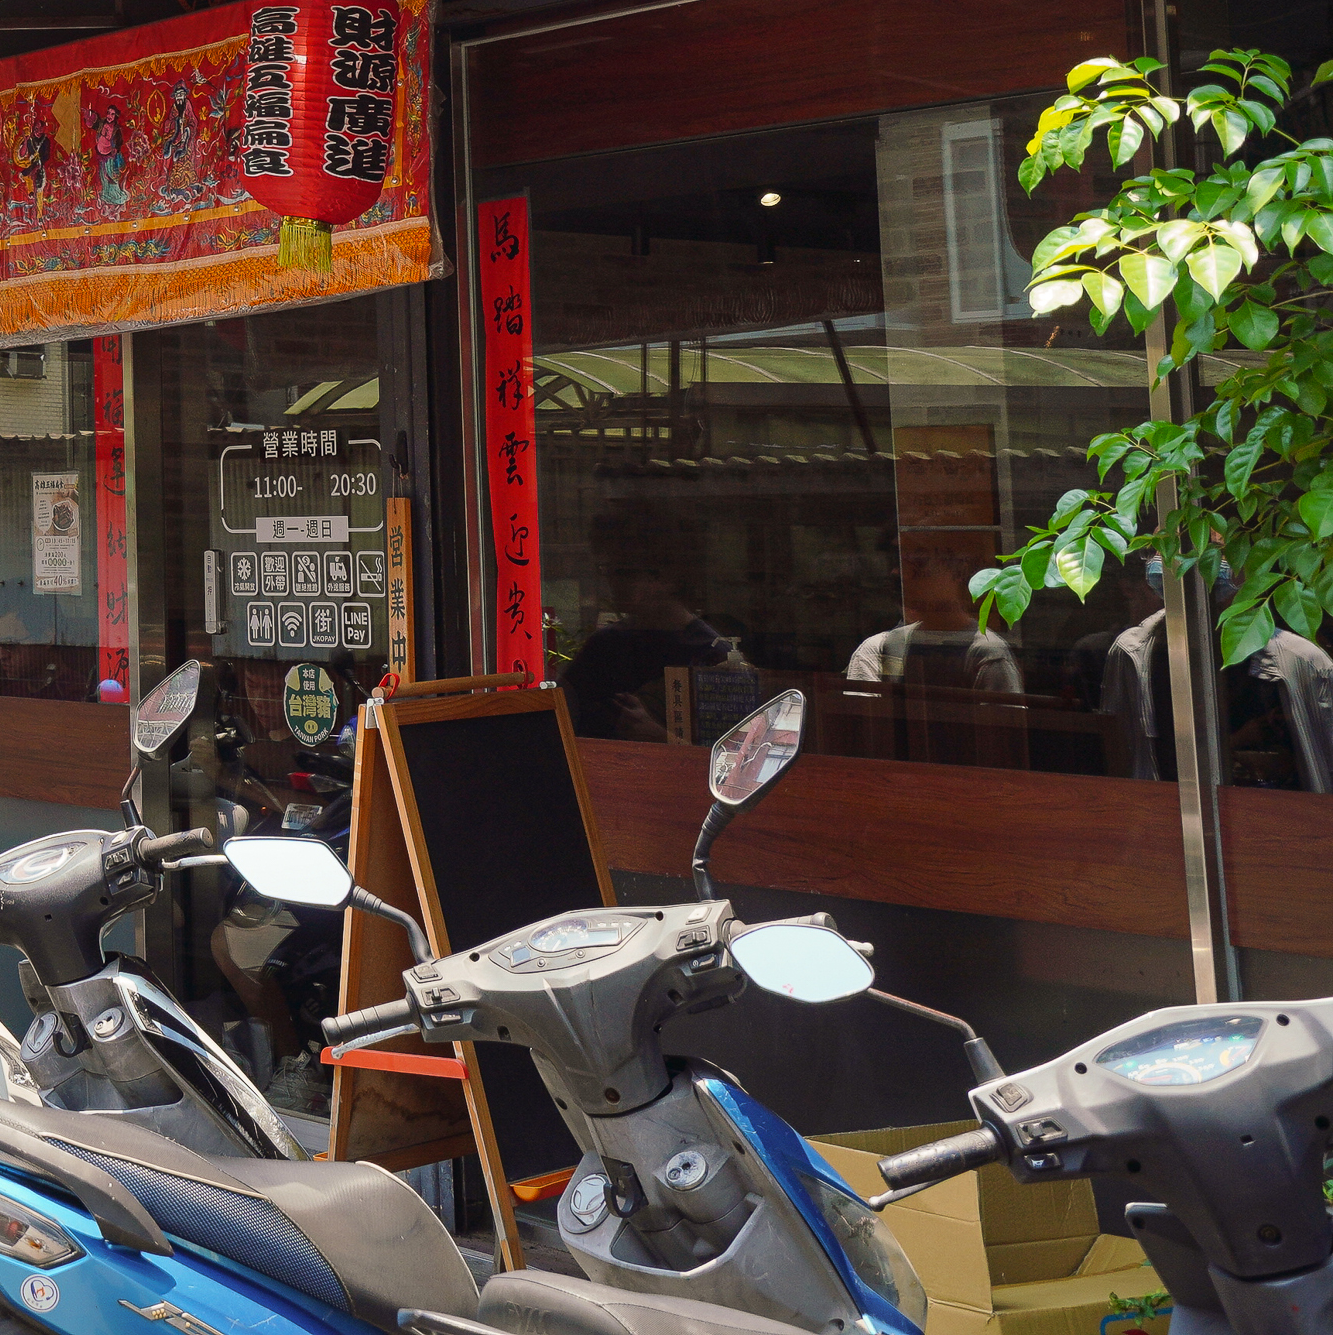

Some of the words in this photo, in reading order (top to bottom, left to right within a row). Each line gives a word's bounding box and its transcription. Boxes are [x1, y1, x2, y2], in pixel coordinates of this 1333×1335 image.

[323, 5, 397, 183] 財源廣進
[263, 429, 338, 459] 營業時間
[490, 213, 532, 672] 馬踏祥雲迎貴
[330, 472, 377, 497] 20:30
[272, 519, 333, 540] 週一-週日
[264, 556, 286, 573] 歡迎
[265, 575, 286, 592] 外帶
[344, 611, 368, 626] LINE
[312, 635, 336, 643] JKOPAY
[347, 627, 366, 643] Pay
[302, 668, 316, 679] 本店
[302, 680, 316, 691] 使用
[288, 693, 331, 719] 台灣豬
[294, 725, 314, 743] TAIWAN
[314, 727, 329, 743] PORK
